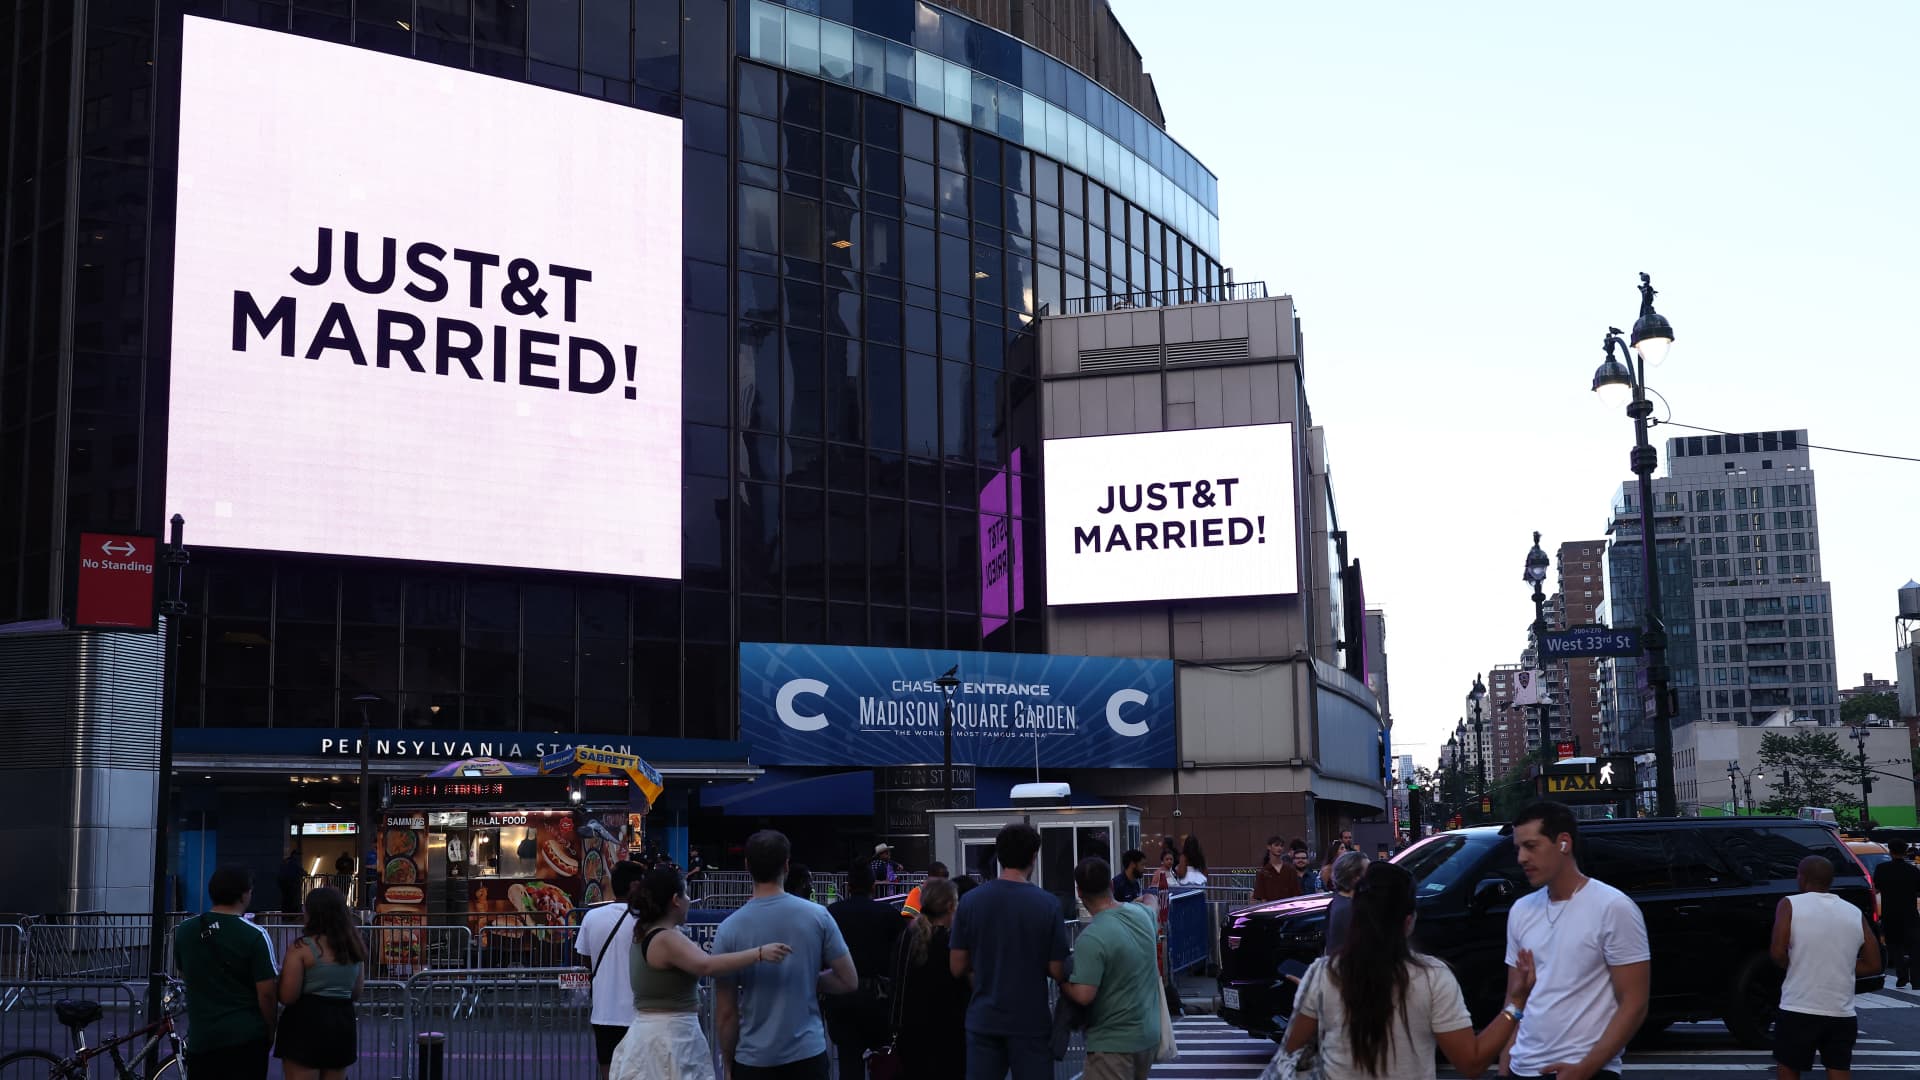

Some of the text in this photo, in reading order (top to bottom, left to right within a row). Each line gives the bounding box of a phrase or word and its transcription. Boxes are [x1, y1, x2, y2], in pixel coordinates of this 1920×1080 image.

[289, 226, 593, 323] JUST&T
[231, 289, 639, 401] MARRIED!
[1096, 477, 1239, 515] JUST&T
[1074, 515, 1267, 554] MARRIED!
[82, 558, 153, 574] No Standing
[1546, 635, 1632, 651] West 33rd St
[892, 679, 1050, 696] CHASE ENTRANCE
[775, 678, 830, 732] C
[859, 696, 939, 727] MADISON
[1105, 688, 1150, 737] C
[321, 738, 522, 757] PENNSYLVANIA
[579, 750, 635, 767] SABRETT
[930, 767, 971, 785] STTION
[1551, 775, 1597, 791] TAX
[472, 816, 527, 826] HALAL FOOD
[561, 973, 592, 982] NATION
